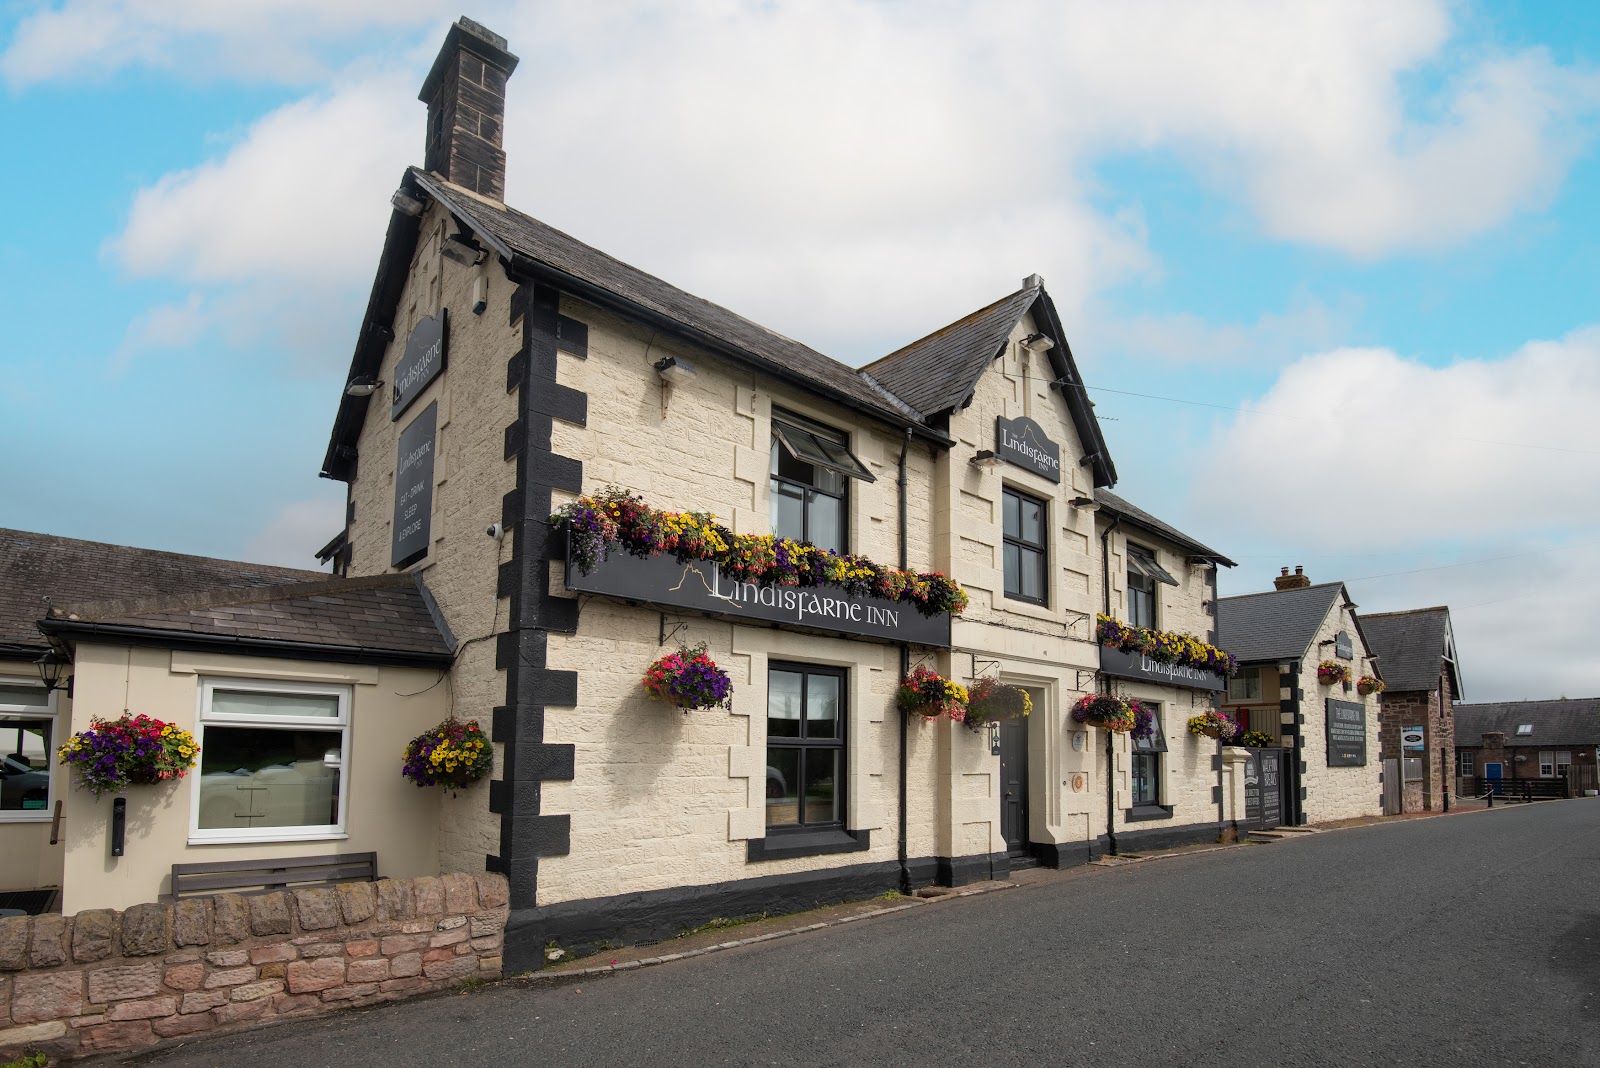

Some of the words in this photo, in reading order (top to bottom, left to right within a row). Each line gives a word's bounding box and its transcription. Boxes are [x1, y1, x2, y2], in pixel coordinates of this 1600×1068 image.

[1002, 428, 1059, 470] Lindisfarne
[1038, 462, 1049, 472] INN
[404, 503, 418, 520] SLEEP
[708, 560, 862, 621] Lindisfarne
[866, 605, 900, 628] INN
[1194, 669, 1207, 681] INN
